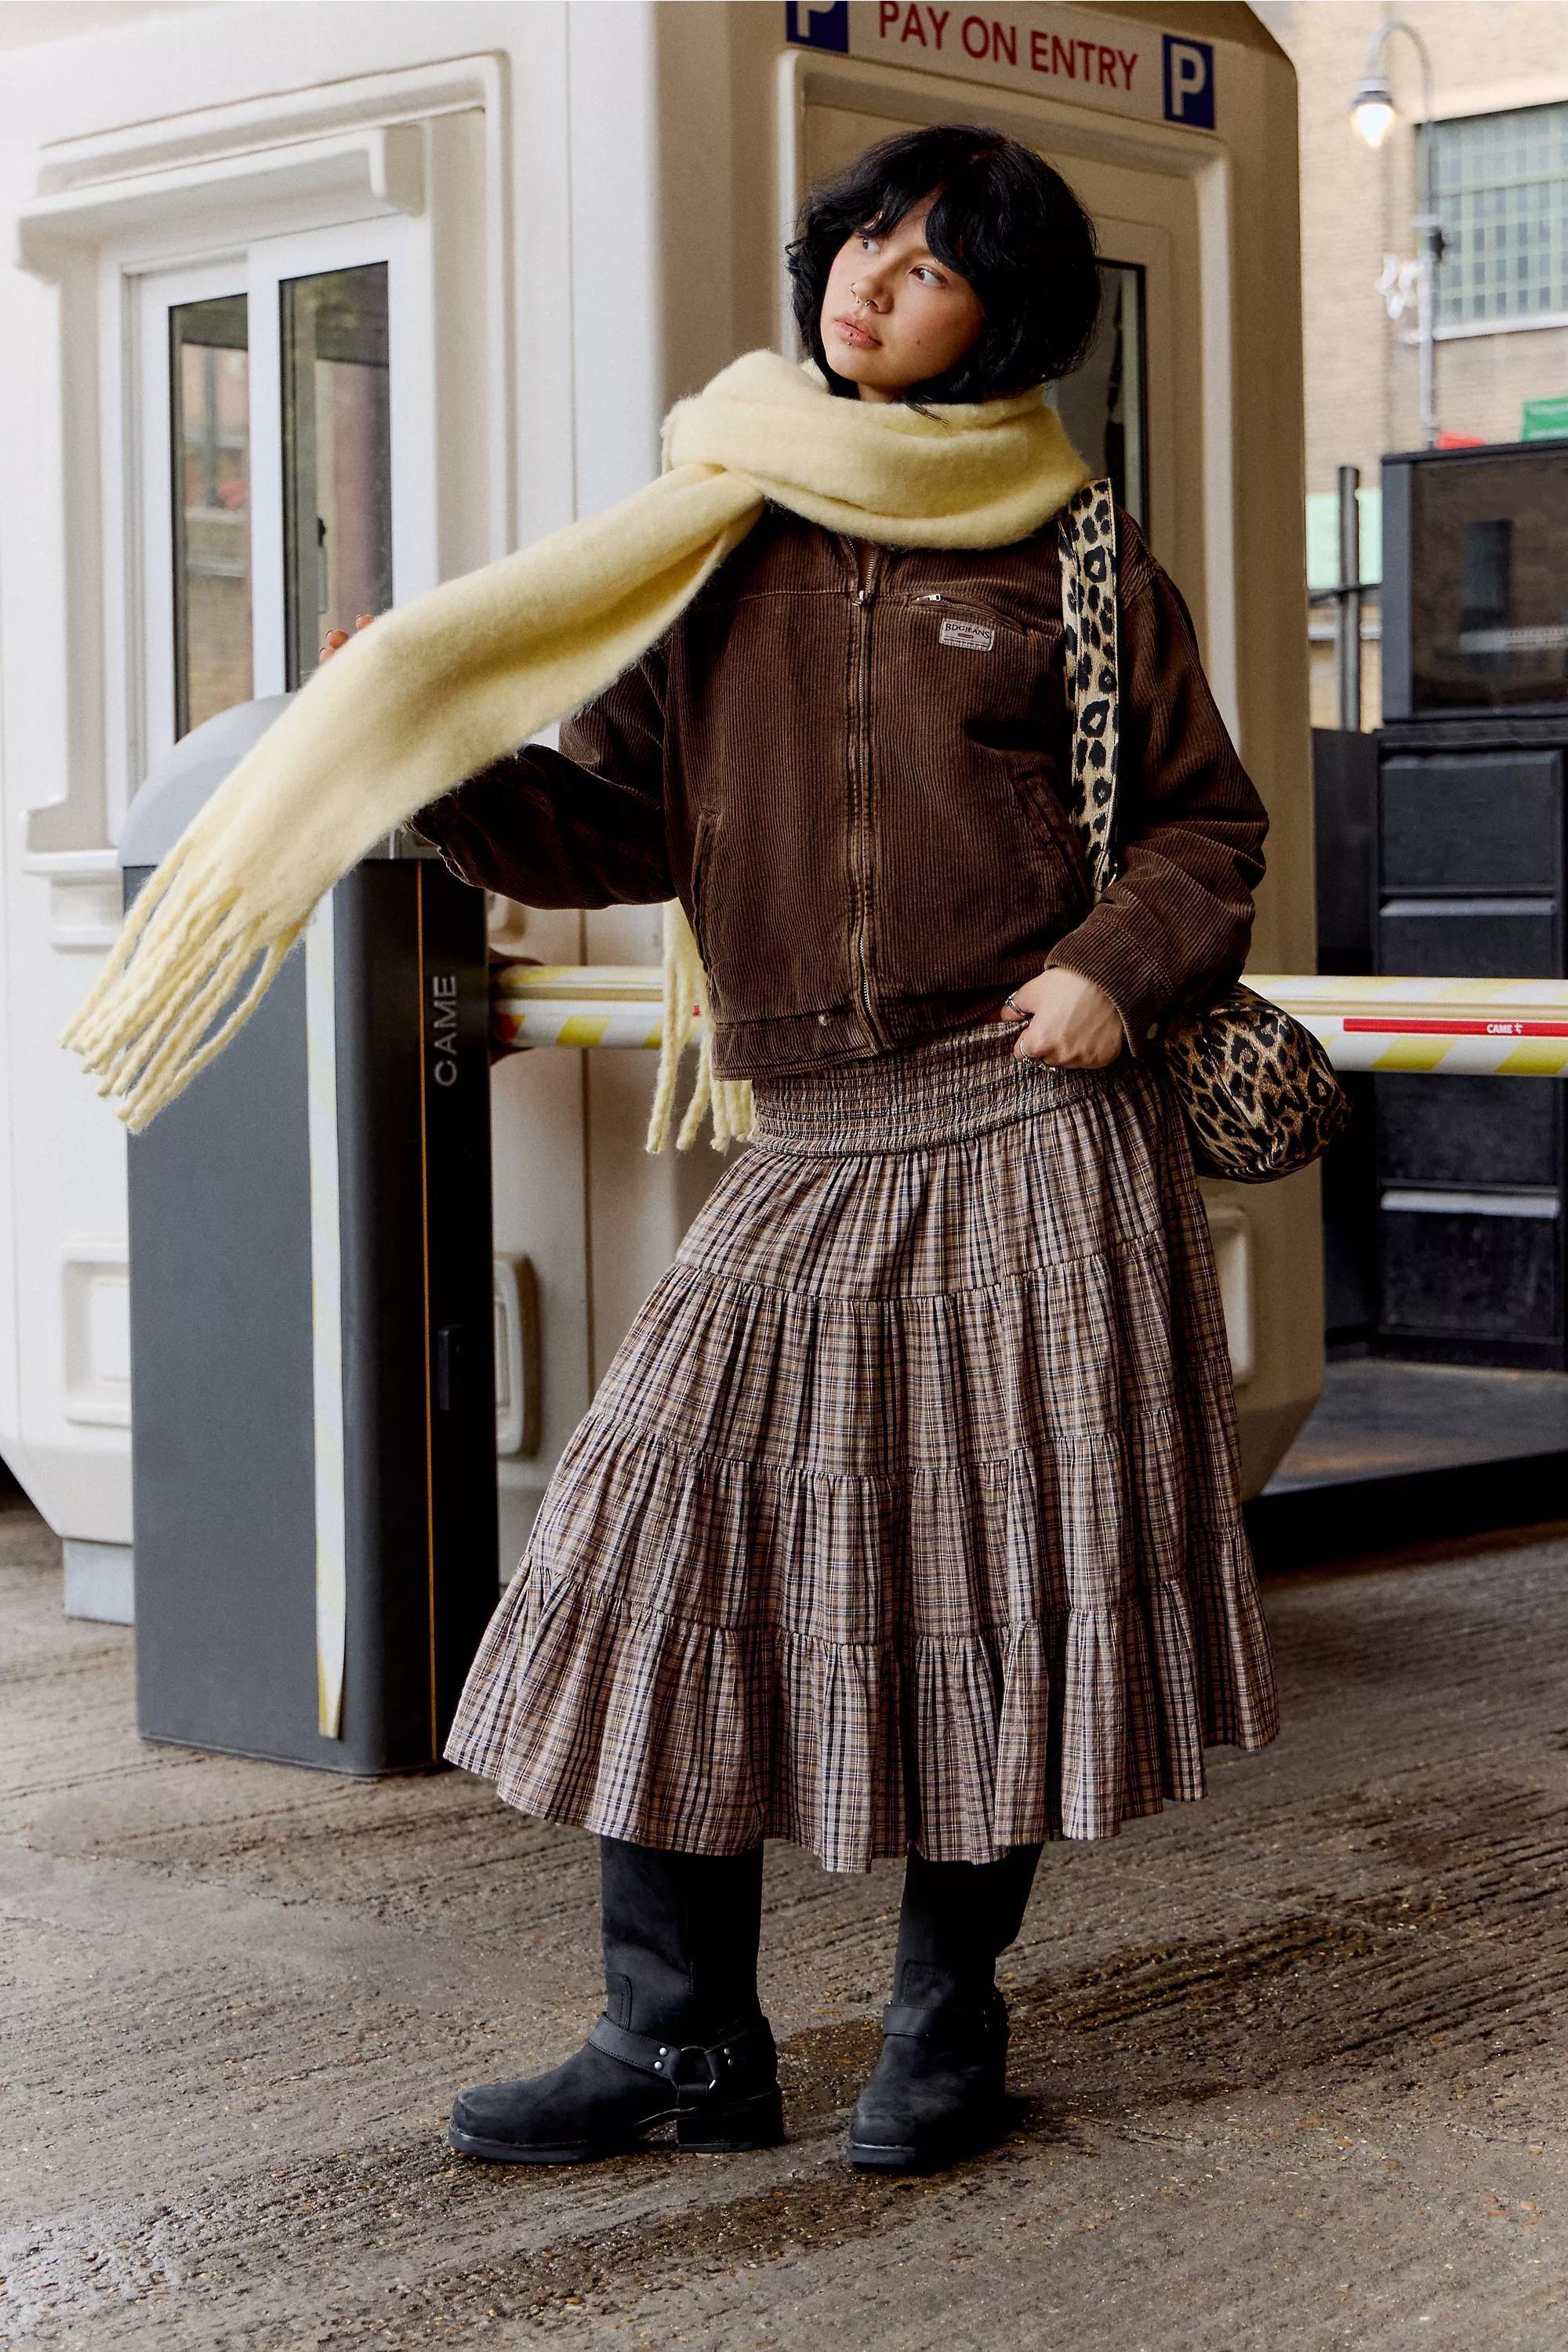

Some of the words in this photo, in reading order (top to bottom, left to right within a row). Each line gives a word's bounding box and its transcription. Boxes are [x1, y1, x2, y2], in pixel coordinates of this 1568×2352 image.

[878, 0, 949, 50] PAY
[962, 16, 1017, 66] ON
[1030, 30, 1138, 91] ENTRY
[1171, 42, 1206, 116] P
[434, 975, 457, 1087] CAME
[1486, 1023, 1512, 1034] CAME
